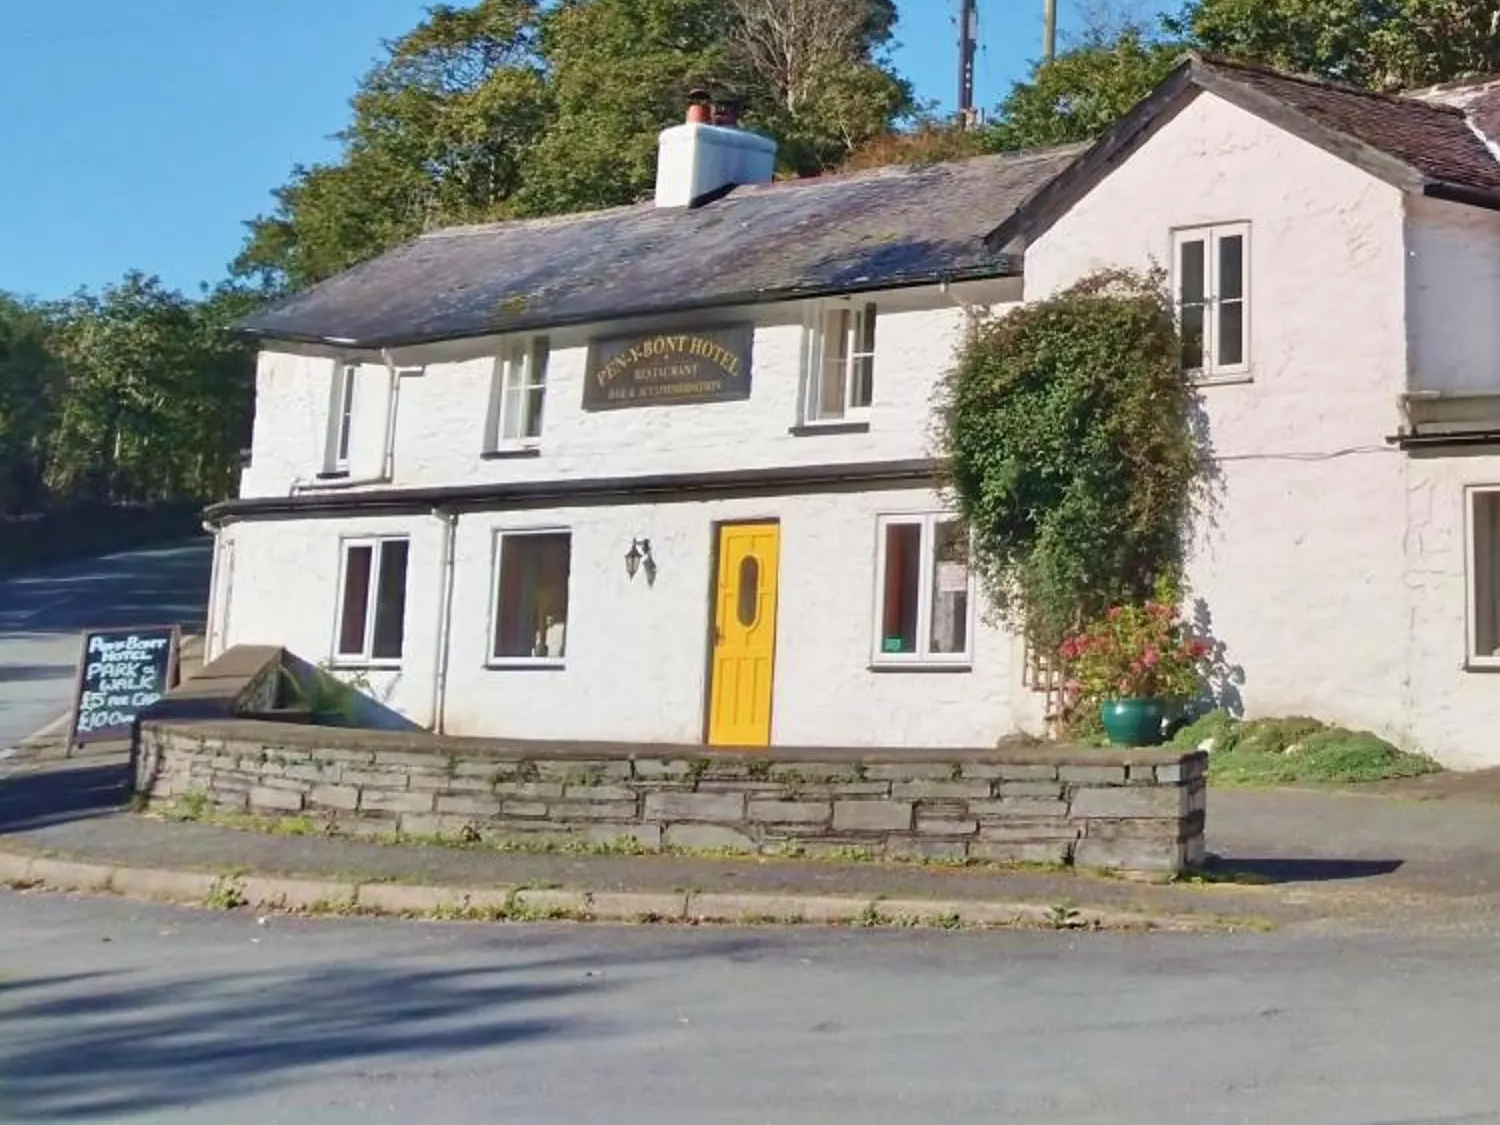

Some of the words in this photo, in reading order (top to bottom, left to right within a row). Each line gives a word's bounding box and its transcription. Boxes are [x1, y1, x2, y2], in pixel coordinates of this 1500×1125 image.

[689, 336, 739, 376] HOTEL
[101, 650, 153, 662] HOTEL
[86, 663, 140, 680] PARK
[99, 676, 154, 691] WALK
[80, 691, 106, 711] £5
